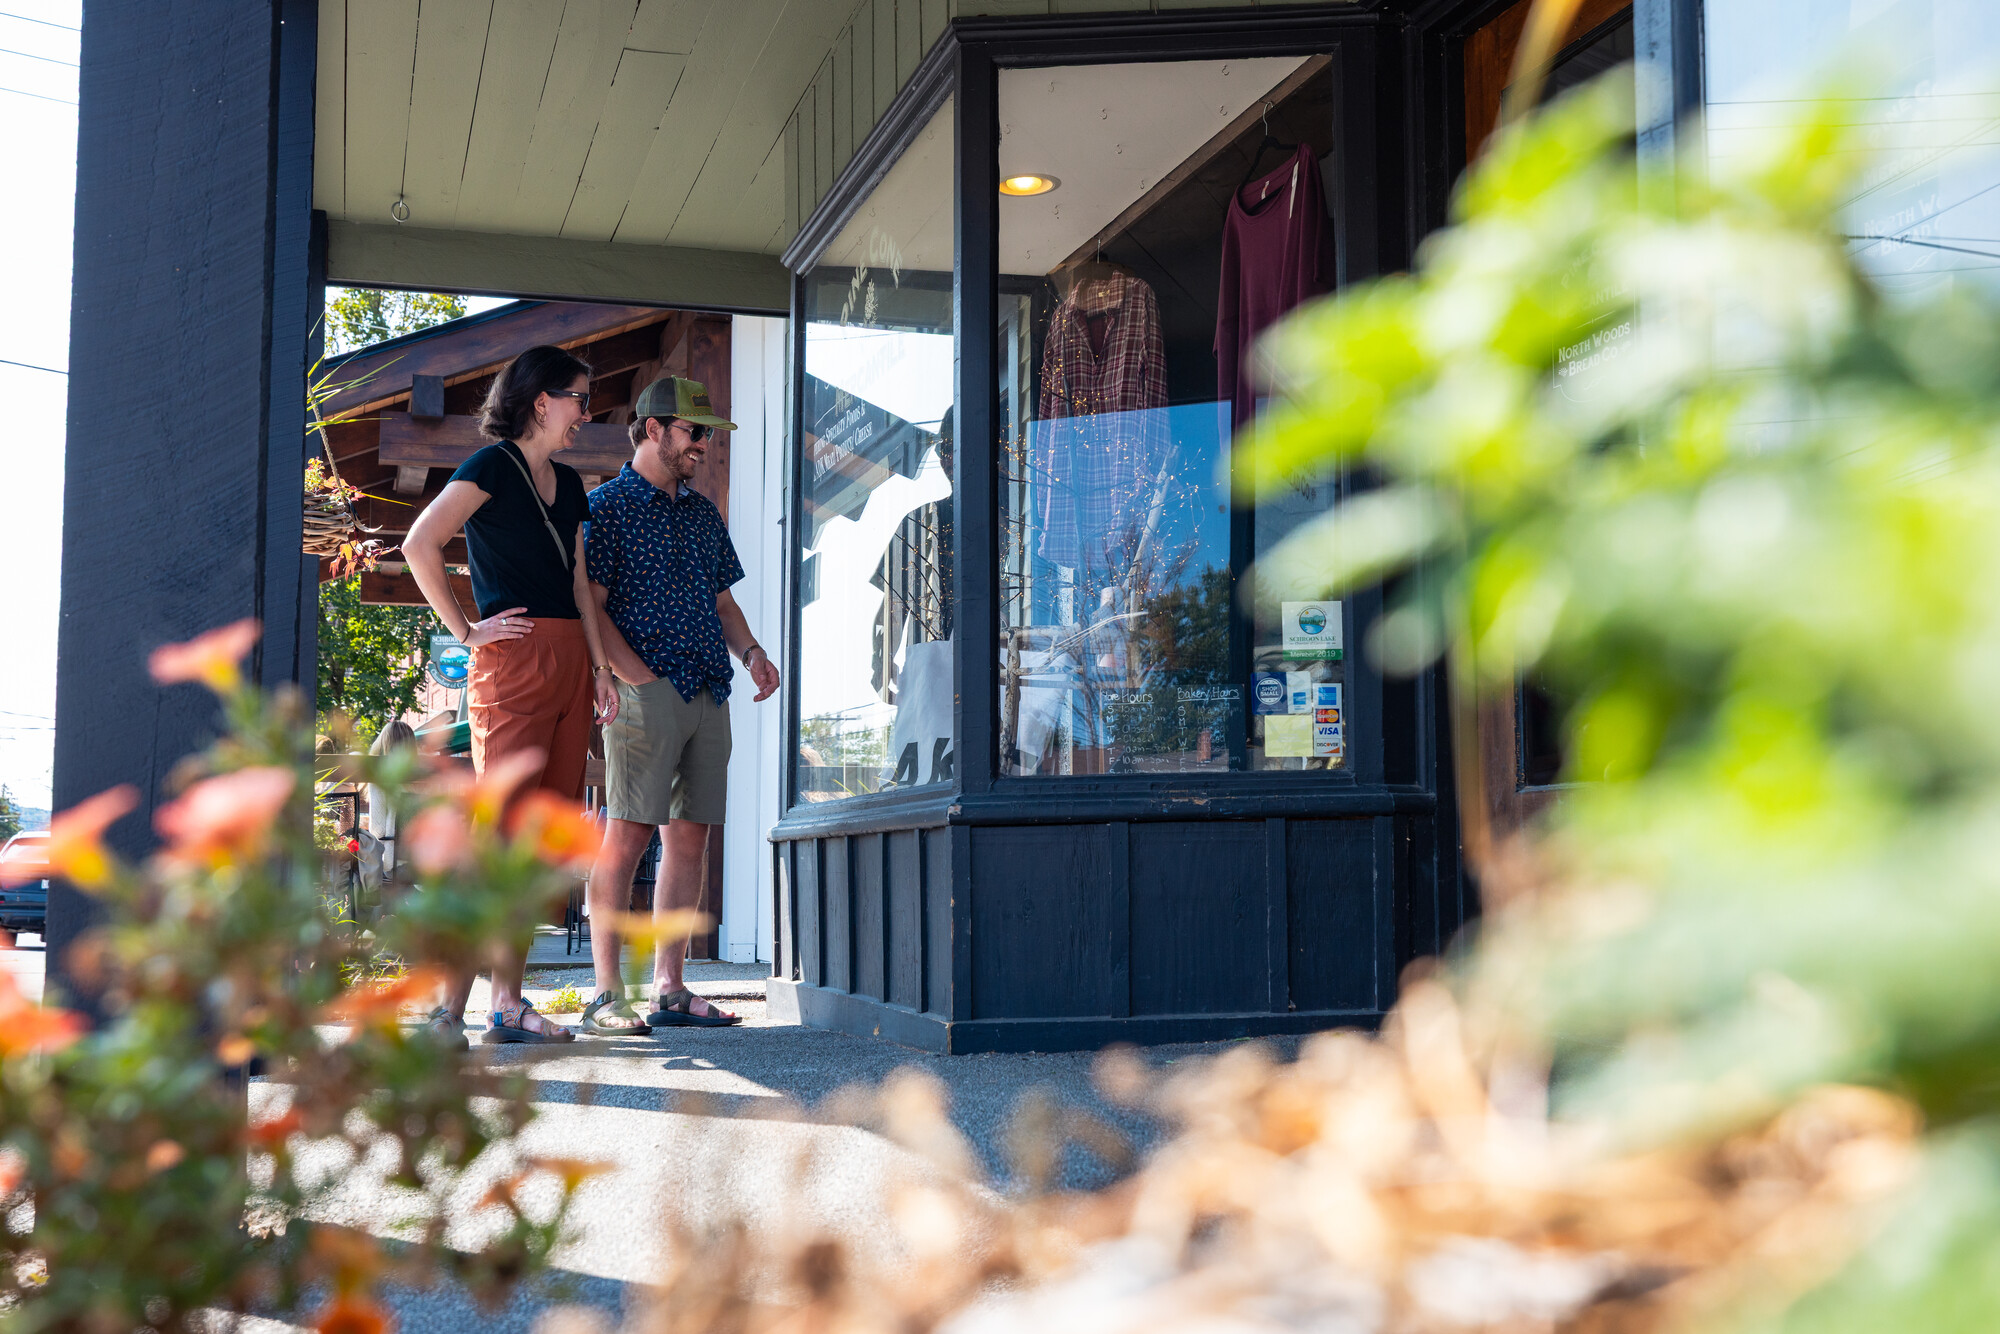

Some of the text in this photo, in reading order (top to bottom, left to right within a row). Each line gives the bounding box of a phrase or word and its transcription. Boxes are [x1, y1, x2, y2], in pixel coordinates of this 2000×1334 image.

[869, 225, 904, 291] CONE
[1558, 321, 1631, 363] NORTH WOODS
[1568, 353, 1600, 377] BREAD
[1316, 650, 1336, 658] 2019
[1121, 690, 1154, 704] Hours
[1177, 687, 1210, 704] Bakery
[1317, 727, 1339, 735] VISA
